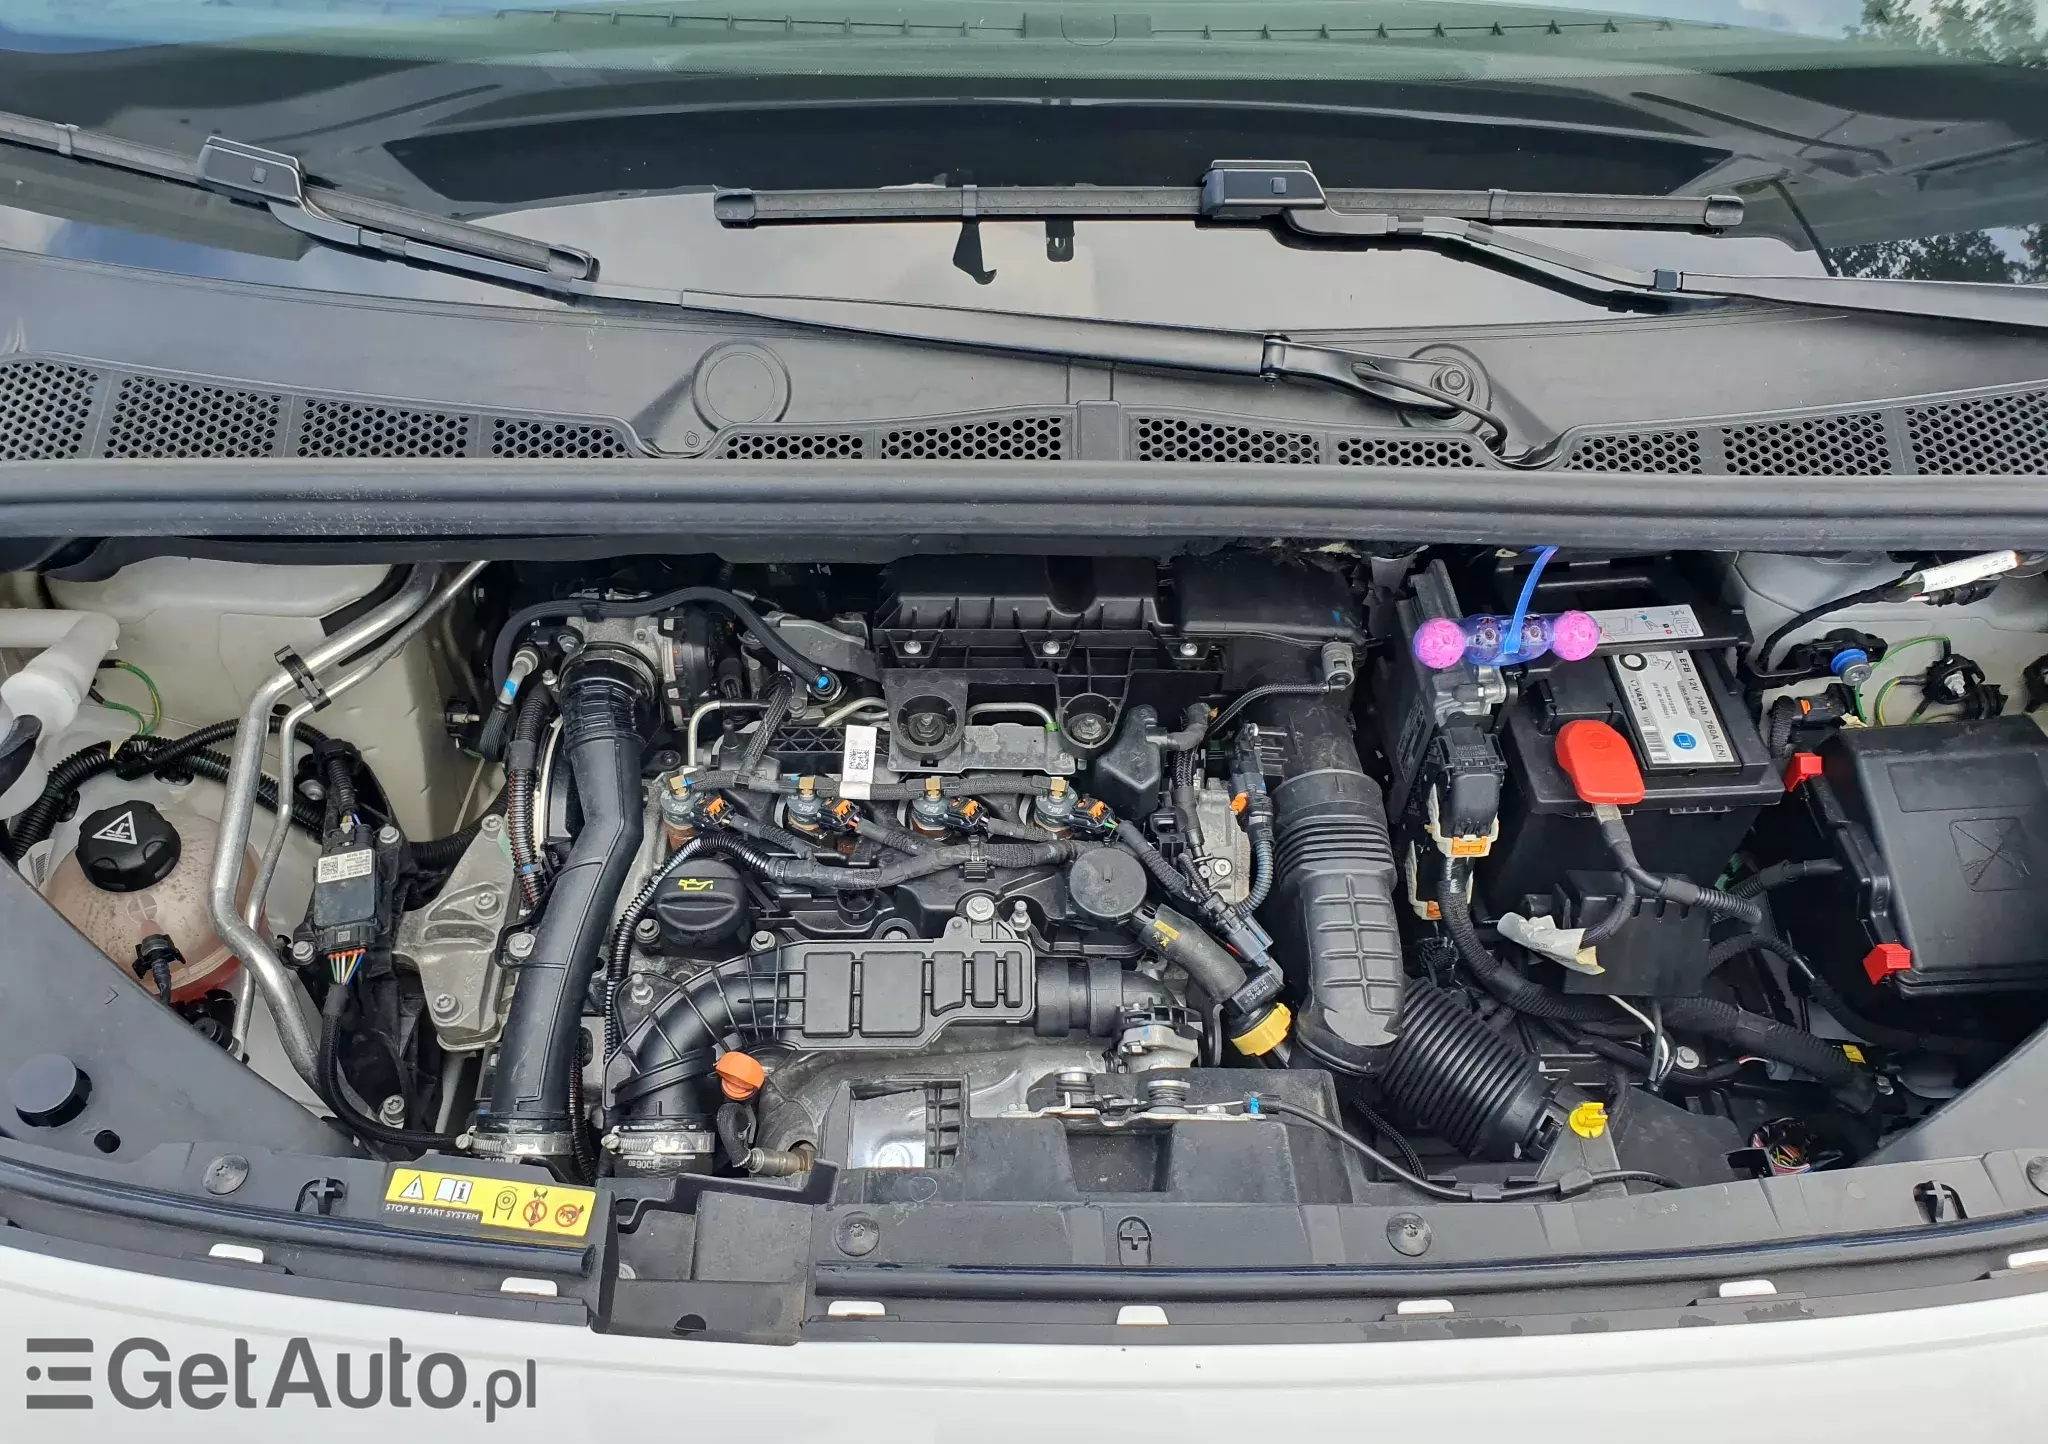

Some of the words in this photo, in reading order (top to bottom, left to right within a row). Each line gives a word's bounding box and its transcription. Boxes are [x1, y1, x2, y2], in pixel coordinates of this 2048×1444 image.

[1633, 687, 1648, 711] VARTA
[1679, 657, 1692, 673] EFB
[1687, 677, 1700, 692] 12V
[1694, 695, 1709, 715] 70Ah
[1703, 719, 1719, 740] 760A
[1711, 741, 1727, 758] (EN)
[385, 1203, 409, 1213] STOP
[417, 1206, 446, 1217] START
[445, 1210, 480, 1221] SYSTEM
